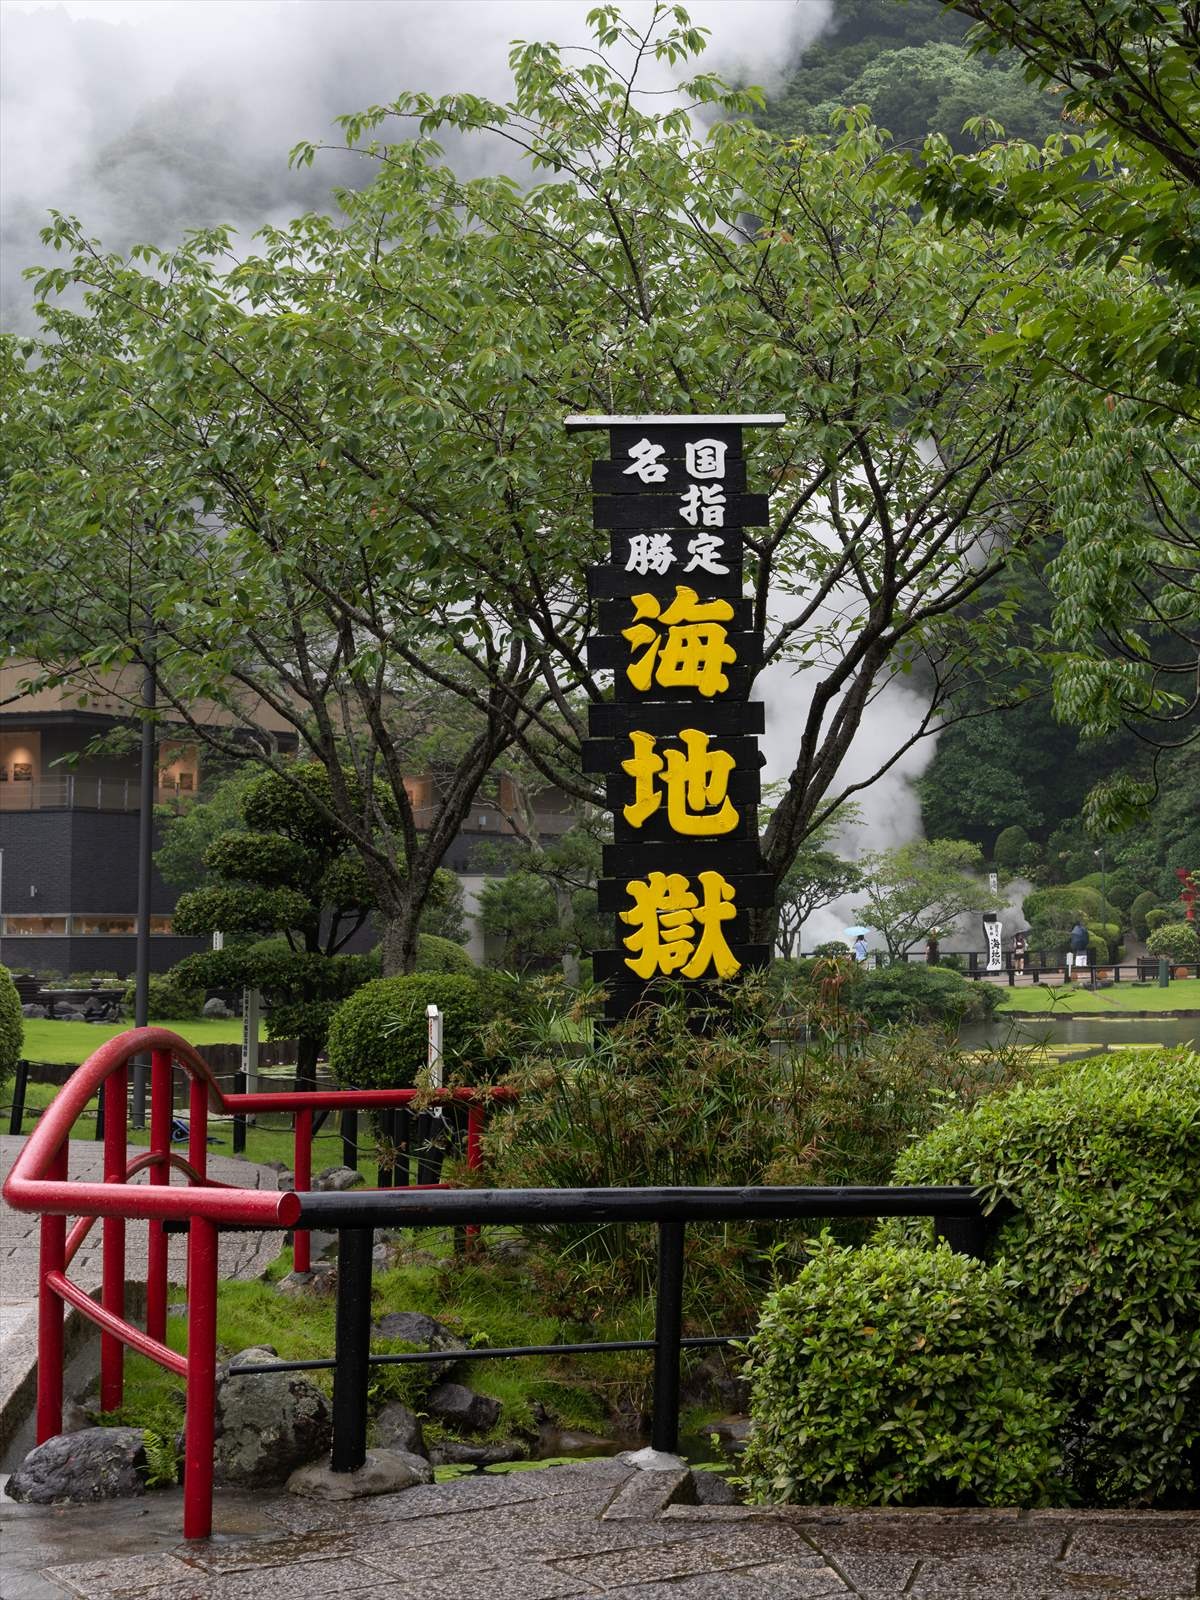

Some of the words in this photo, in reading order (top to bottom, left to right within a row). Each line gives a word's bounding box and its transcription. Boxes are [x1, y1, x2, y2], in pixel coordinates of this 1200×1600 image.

[622, 438, 678, 575] 名勝
[679, 438, 730, 575] 国指定
[619, 585, 741, 979] 海地獄
